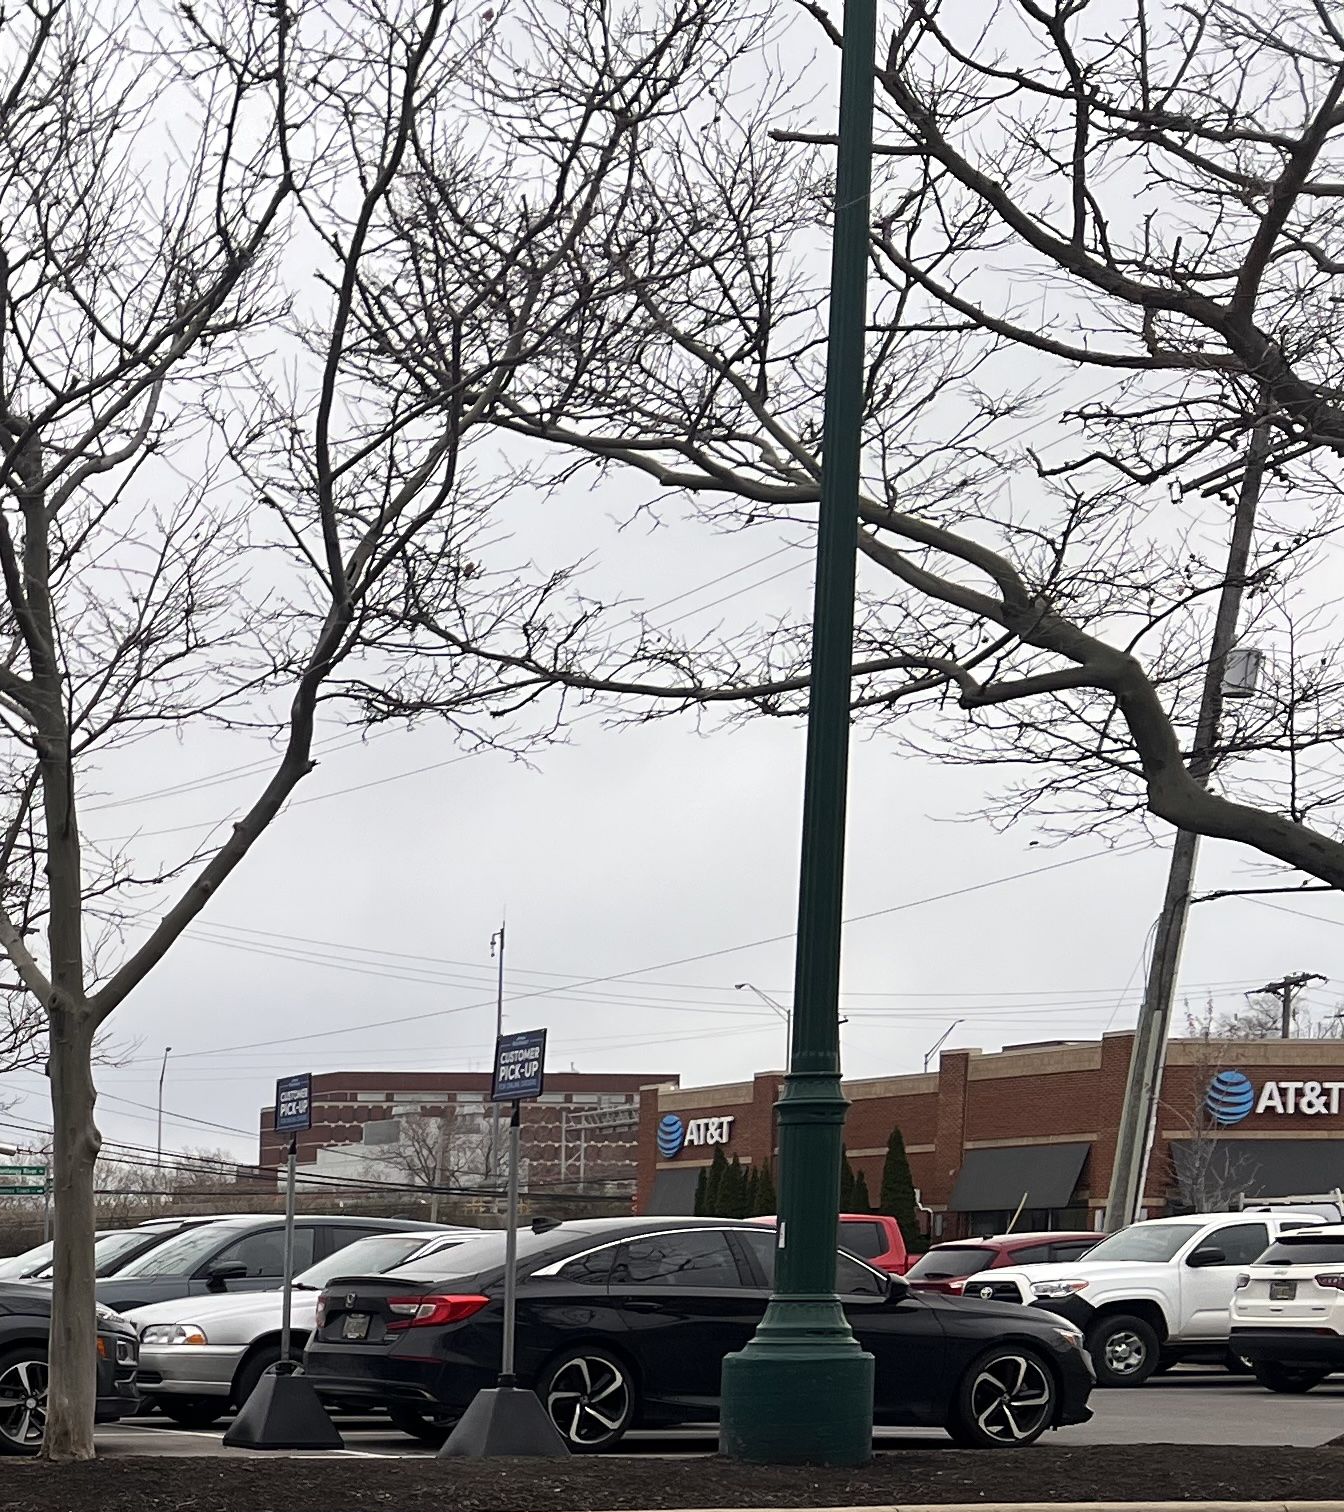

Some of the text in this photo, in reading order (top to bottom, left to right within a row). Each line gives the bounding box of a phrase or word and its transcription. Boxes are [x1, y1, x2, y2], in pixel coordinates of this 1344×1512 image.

[500, 1046, 540, 1064] CUSTOMER
[498, 1061, 539, 1082] PICK-UP
[1255, 1081, 1344, 1115] AT&T
[683, 1115, 735, 1147] AT&T
